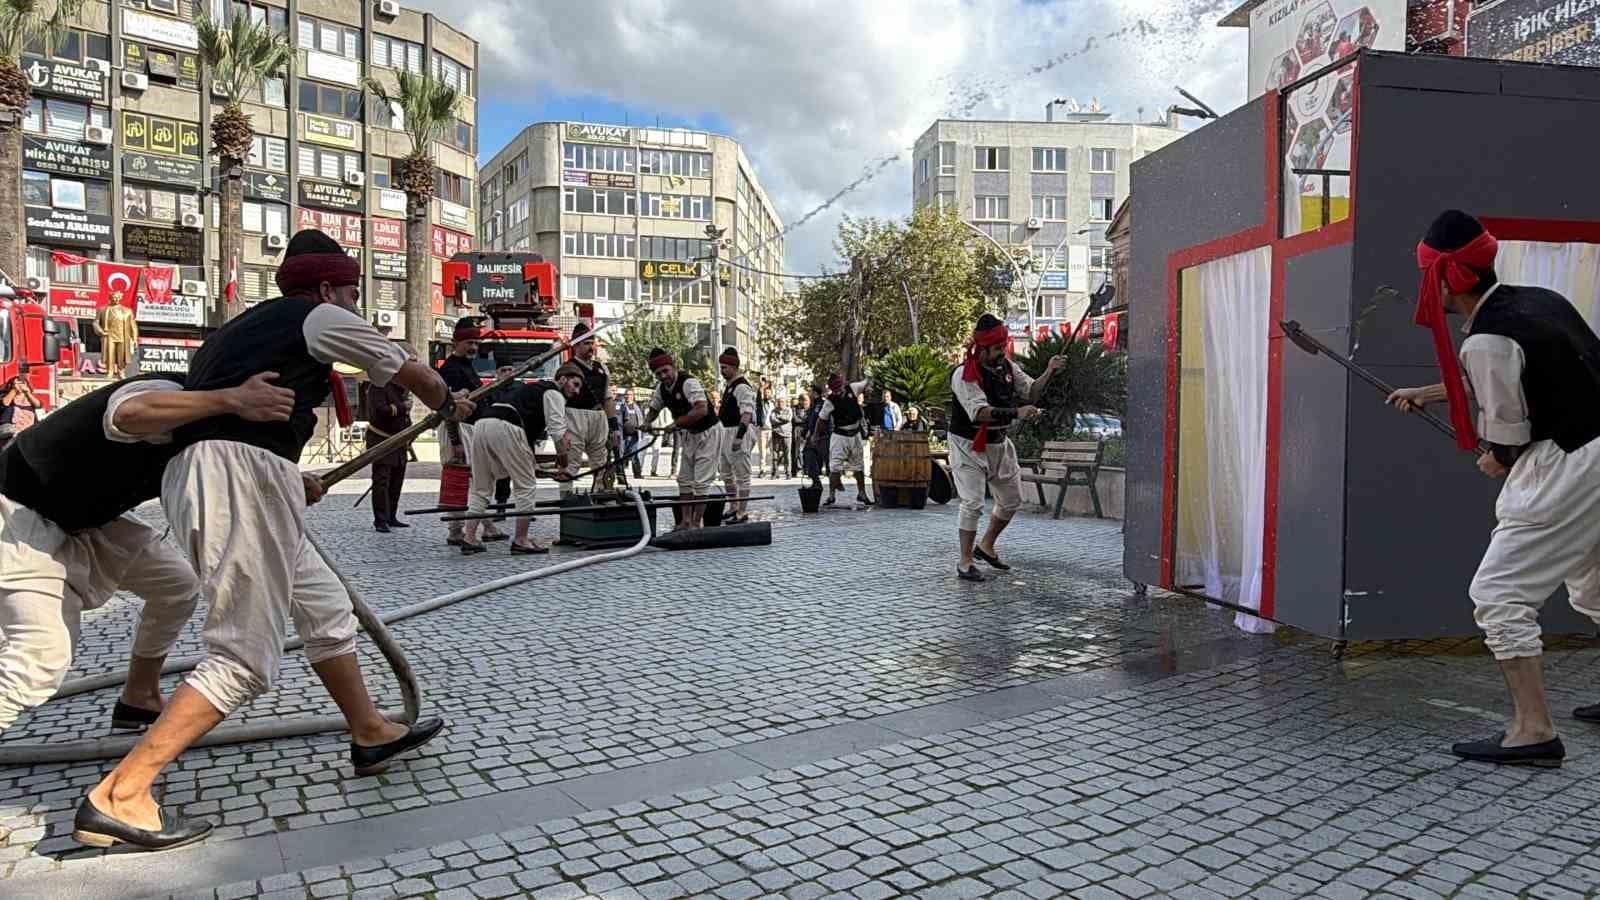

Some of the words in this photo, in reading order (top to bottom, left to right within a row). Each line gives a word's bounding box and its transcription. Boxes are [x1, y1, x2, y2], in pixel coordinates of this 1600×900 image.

[53, 64, 101, 81] AVUKAT
[580, 125, 629, 137] AVUKAT
[45, 141, 91, 156] AVUKAT
[314, 184, 352, 198] AVUKAT
[51, 211, 88, 222] Avukat
[302, 210, 316, 223] AL
[321, 212, 342, 226] MAN
[27, 217, 65, 230] Serhat
[66, 221, 110, 234] ARASAN
[477, 263, 522, 274] BALIKESİR
[482, 286, 515, 298] İTFAİYE
[137, 295, 199, 307] AKAT
[143, 346, 188, 360] ZEYTİN
[140, 360, 189, 374] ZEYTİNYAĞI
